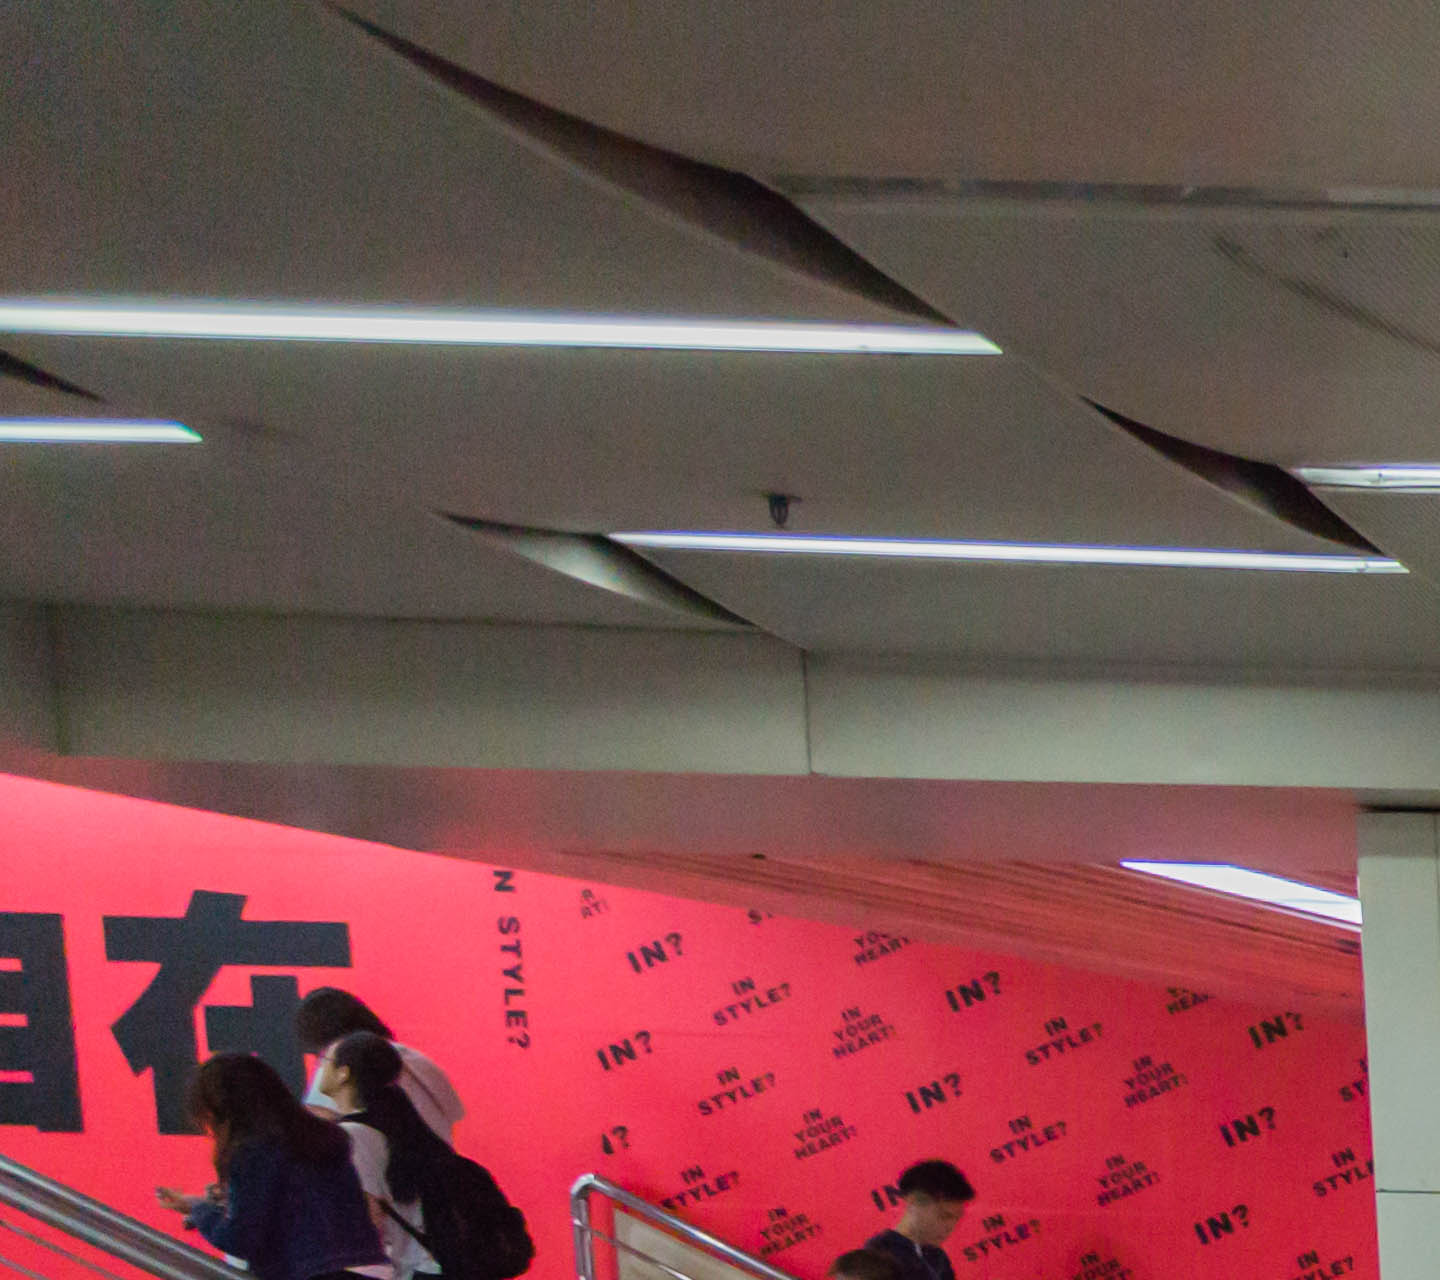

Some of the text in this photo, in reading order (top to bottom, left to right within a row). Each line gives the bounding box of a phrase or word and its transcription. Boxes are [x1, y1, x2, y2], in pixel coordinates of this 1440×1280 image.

[491, 868, 530, 1052] N STYLE?
[626, 932, 683, 973] IN?
[732, 977, 755, 996] IN
[945, 971, 1000, 1012] IN?
[713, 982, 791, 1026] STYLE?
[841, 1007, 861, 1022] IN
[832, 1024, 896, 1060] HEART!
[833, 1013, 883, 1042] YOUR
[1045, 1017, 1068, 1036] IN
[1247, 1011, 1304, 1049] IN?
[597, 1030, 653, 1071] IN?
[1026, 1023, 1103, 1066] STYLE?
[716, 1066, 741, 1085] IN
[1124, 1062, 1174, 1090] YOUR
[1134, 1056, 1153, 1071] IN
[698, 1072, 776, 1116] STYLE?
[905, 1073, 962, 1114] IN?
[1124, 1074, 1188, 1108] HEART!
[794, 1116, 844, 1142] YOUR
[803, 1109, 823, 1124] IN
[1009, 1115, 1033, 1134] IN
[1218, 1106, 1276, 1148] IN?
[794, 1126, 857, 1160] HEART!
[990, 1121, 1066, 1164] STYLE?
[1332, 1148, 1355, 1167] IN
[681, 1165, 705, 1185] IN
[1097, 1161, 1148, 1189] YOUR
[1106, 1155, 1125, 1170] IN
[659, 1170, 739, 1211] STYLE?
[1097, 1172, 1159, 1207] HEART!
[1313, 1160, 1374, 1197] STYL
[870, 1181, 902, 1212] IN
[760, 1214, 808, 1240] YOUR
[768, 1207, 787, 1221] IN
[983, 1215, 1005, 1231] IN
[1194, 1204, 1249, 1245] IN?
[963, 1219, 1040, 1262] STYLE?
[1081, 1252, 1099, 1267] IN
[1297, 1250, 1320, 1269] IN
